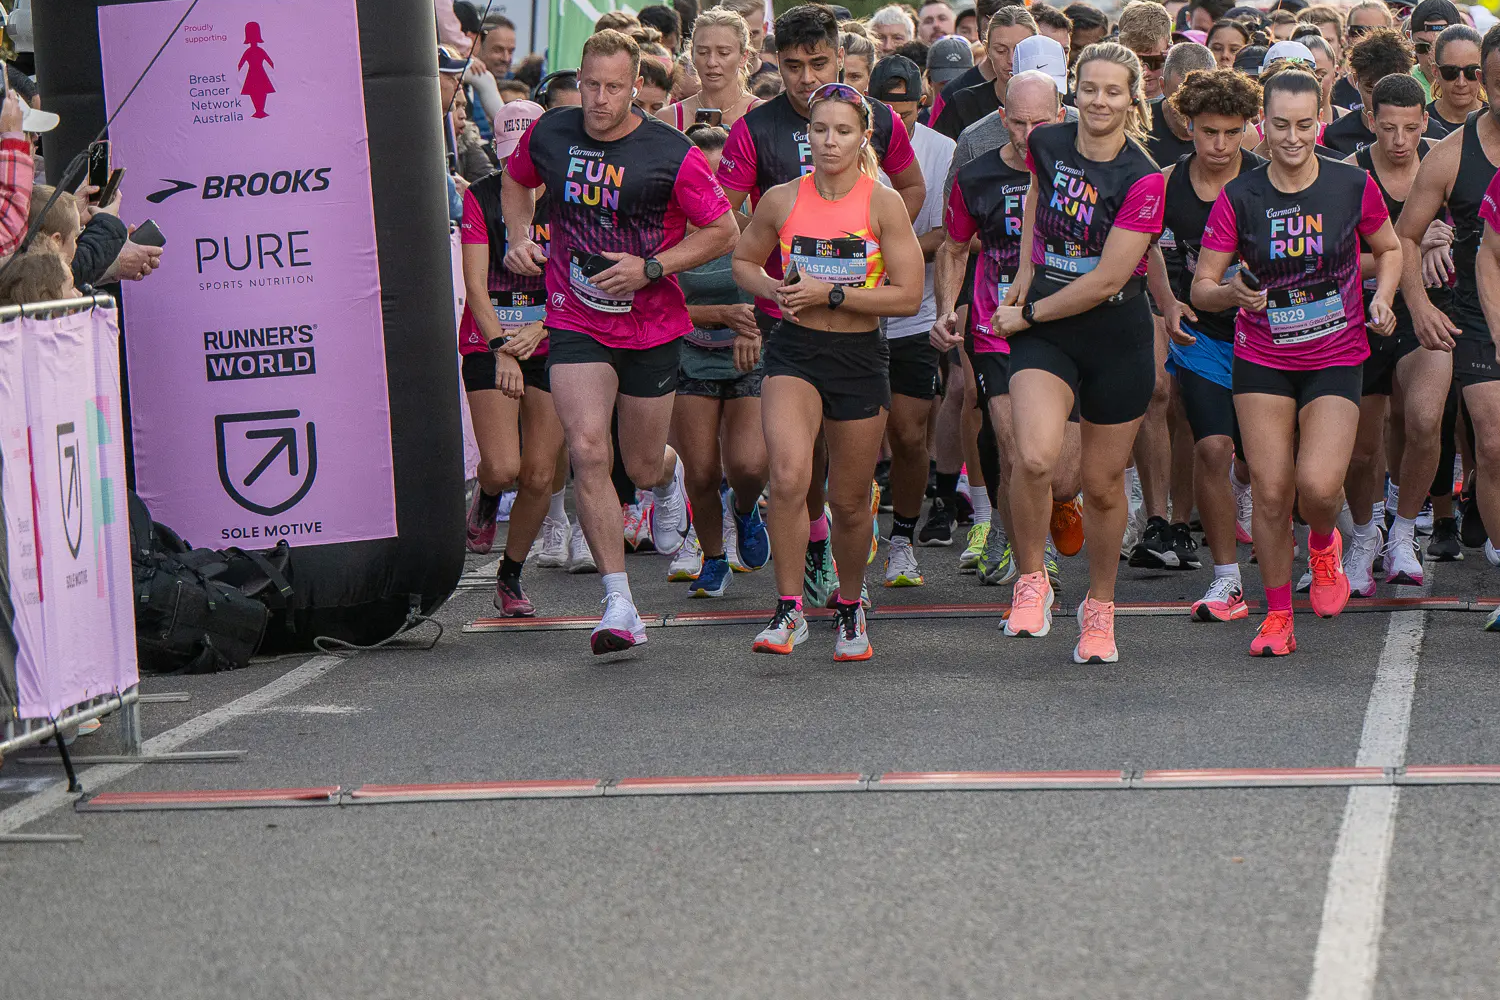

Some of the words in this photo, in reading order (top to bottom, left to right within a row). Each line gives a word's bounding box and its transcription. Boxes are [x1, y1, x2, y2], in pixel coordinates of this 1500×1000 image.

[184, 23, 214, 34] Proudly
[184, 32, 228, 44] supporting
[189, 73, 227, 85] Breast
[189, 85, 230, 98] Cancer
[191, 98, 242, 111] Network
[192, 111, 244, 125] Australia
[503, 118, 520, 133] MEL'S
[521, 118, 535, 131] AR
[568, 145, 605, 158] Carman's
[566, 156, 625, 188] FUN
[1054, 159, 1086, 176] Carman's
[202, 168, 332, 200] BROOKS
[1052, 171, 1099, 204] FUN
[564, 181, 620, 211] RUN
[1050, 190, 1095, 225] RUN
[1265, 204, 1301, 219] Carman's
[1270, 213, 1323, 239] FUN
[195, 230, 312, 274] PURE
[1269, 236, 1324, 260] RUN
[799, 262, 848, 275] NASTASIA
[1048, 256, 1078, 272] 5576
[199, 280, 243, 291] SPORTS
[249, 275, 314, 288] NUTRITION
[1271, 308, 1306, 324] 5829
[209, 350, 312, 377] WORLD
[221, 526, 260, 539] SOLE
[264, 521, 322, 537] MOTIVE
